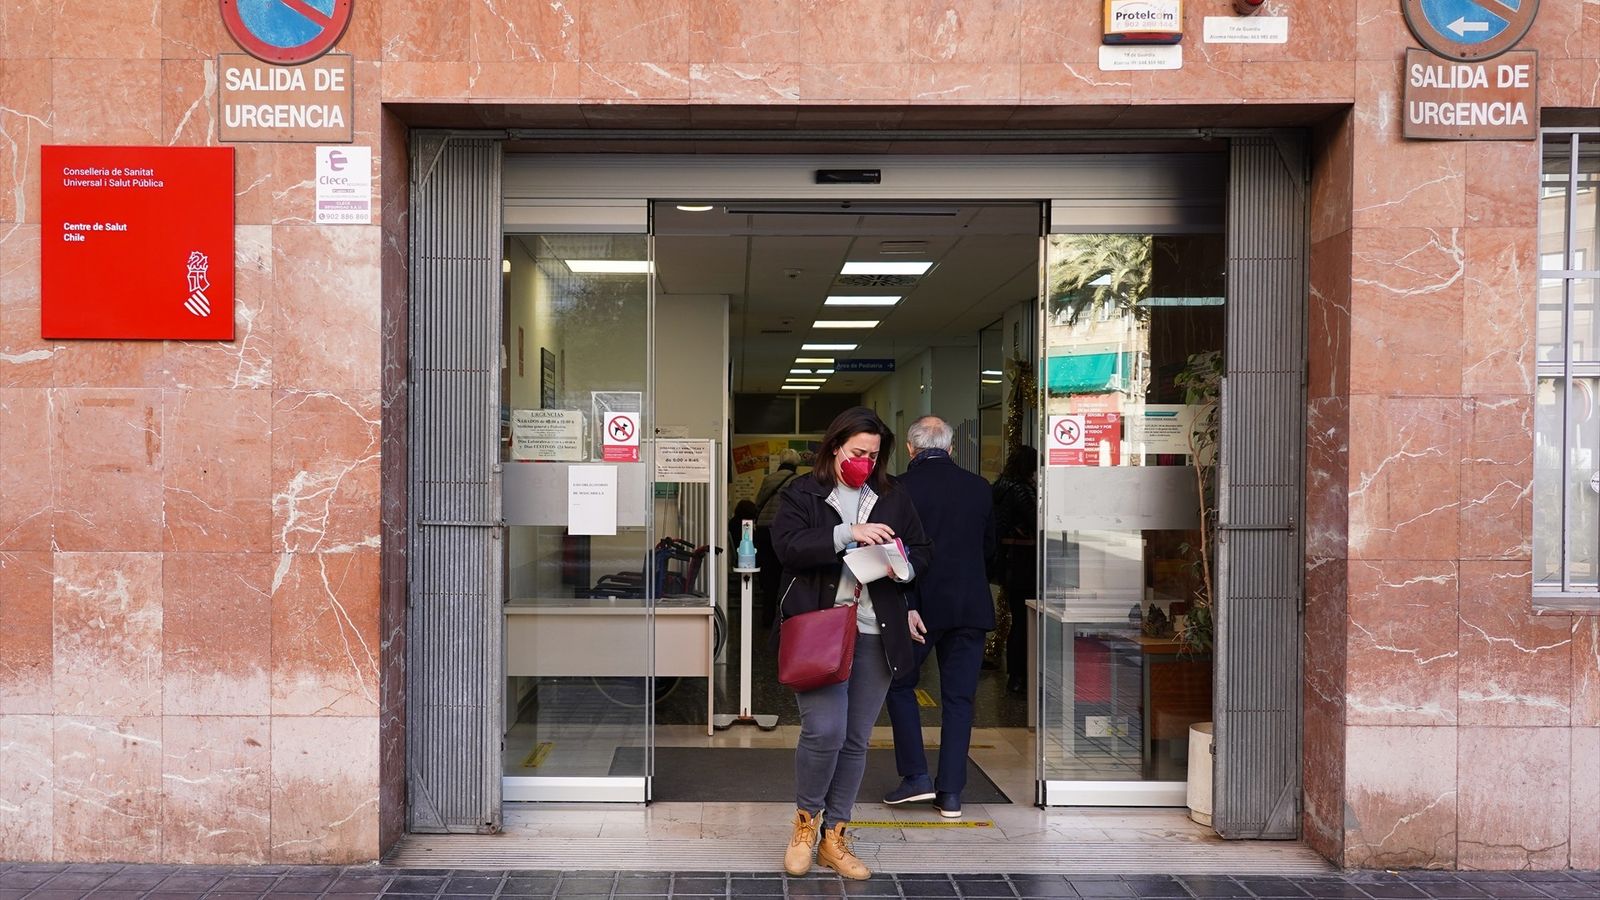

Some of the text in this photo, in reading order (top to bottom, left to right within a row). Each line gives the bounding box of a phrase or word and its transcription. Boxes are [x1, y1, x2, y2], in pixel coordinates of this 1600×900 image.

[1116, 11, 1174, 20] Protelcom
[225, 67, 345, 91] SALIDA DE
[1410, 64, 1529, 88] SALIDA DE
[225, 104, 345, 128] URGENCIA
[1410, 101, 1528, 125] URGENCIA
[63, 167, 109, 175] Conselleria
[124, 168, 154, 176] Sanitat
[109, 179, 131, 187] Salut
[132, 179, 164, 187] Pública
[319, 175, 348, 185] Clece
[63, 222, 127, 231] Centre de Salut
[63, 233, 85, 242] Chile
